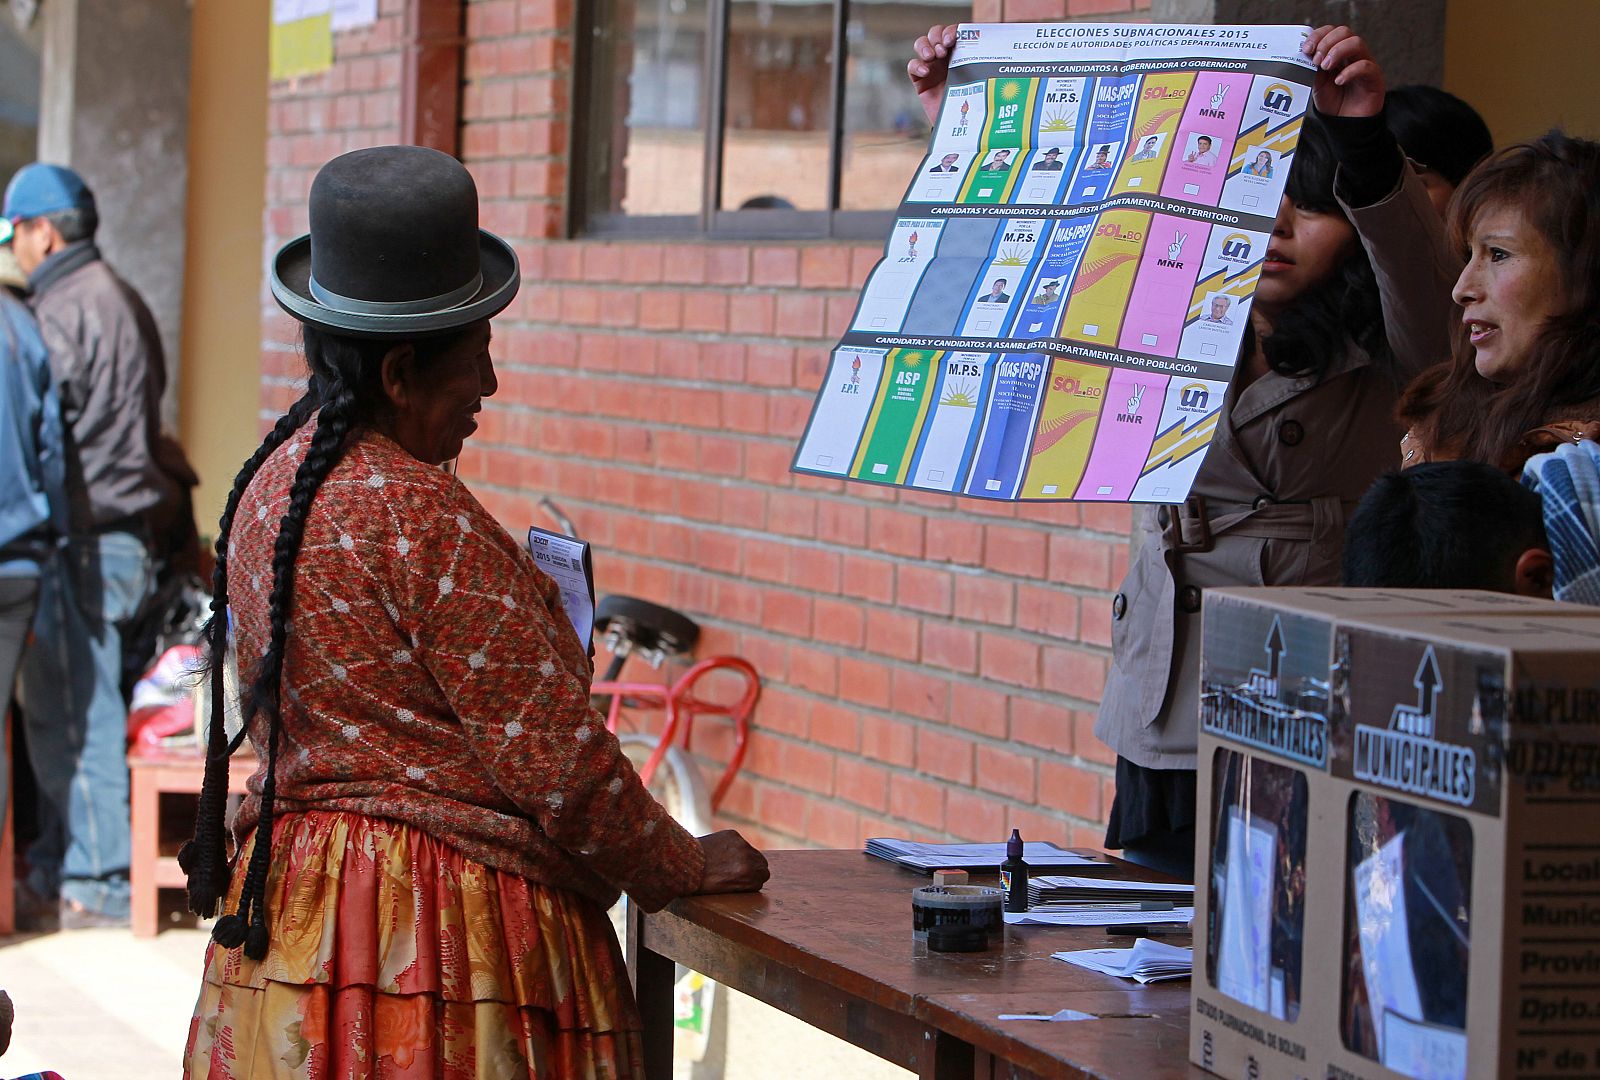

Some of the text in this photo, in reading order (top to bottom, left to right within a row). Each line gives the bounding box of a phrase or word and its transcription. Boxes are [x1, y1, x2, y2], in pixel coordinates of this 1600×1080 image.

[1036, 28, 1249, 39] ELECCIONES SUBNACIONALES 2015
[1013, 41, 1055, 49] ELECCIÓN
[1071, 41, 1133, 49] AUTORIDADES
[1133, 39, 1179, 47] POLÍTICAS
[1181, 40, 1268, 50] DEPARTAMENTALES
[1058, 65, 1111, 73] CANDIDATOS
[1120, 61, 1179, 73] GOBERNADORA
[1188, 60, 1248, 70] GOBERNADOR
[1045, 93, 1080, 103] M.P.S.
[1143, 87, 1187, 100] SOL.BO
[998, 104, 1019, 119] ASP
[1199, 108, 1226, 119] MNR
[931, 207, 980, 215] CANDIDATAS
[988, 208, 1040, 216] CANDIDATOS
[1048, 205, 1099, 217] ASAMBLEISTA
[1099, 198, 1166, 211] DEPARTAMENTAL
[1166, 203, 1185, 214] POR
[1185, 207, 1240, 224] TERRITORIO
[1003, 232, 1036, 243] M.P.S.
[1157, 259, 1184, 270] MNR
[876, 337, 1198, 374] CANDIDATAS Y CANDIDATOS A ASAMBLEISTA DEPARTAMENTAL POR POBLACIÓN
[949, 363, 982, 377] M.P.S.
[896, 371, 921, 386] ASP
[1117, 413, 1143, 424] MNR
[1353, 724, 1477, 807] MUNICIPALES
[1267, 1032, 1278, 1051] DE
